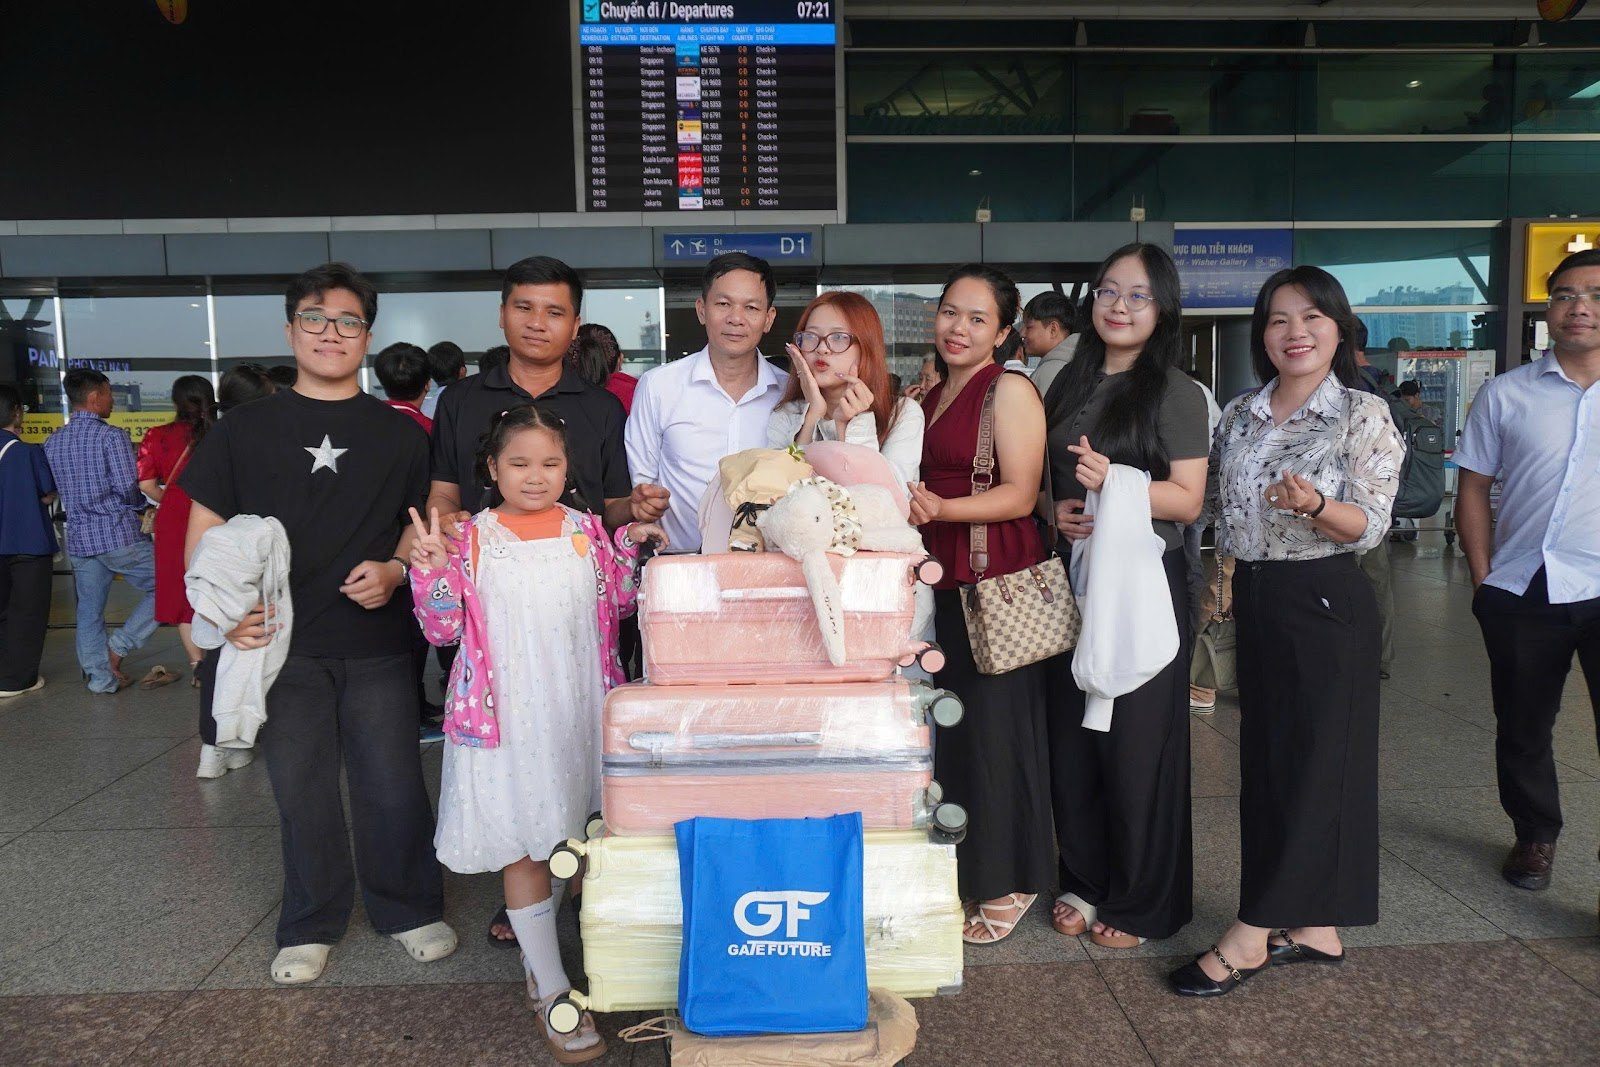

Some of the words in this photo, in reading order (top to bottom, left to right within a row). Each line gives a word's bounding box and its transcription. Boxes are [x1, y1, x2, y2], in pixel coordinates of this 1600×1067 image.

[600, 0, 644, 22] Chuyến
[647, 2, 660, 18] đi
[670, 2, 734, 22] Departures
[797, 2, 830, 18] 07:21
[640, 57, 664, 65] Singapore
[640, 68, 664, 76] Singapore
[641, 79, 664, 87] Singapore
[641, 90, 664, 98] Singapore
[641, 101, 665, 109] Singapore
[642, 112, 665, 120] Singapore
[642, 123, 665, 131] Singapore
[642, 134, 666, 142] Singapore
[642, 145, 666, 153] Singapore
[657, 156, 674, 164] Lumpur
[654, 178, 672, 187] Mueang
[780, 237, 805, 254] D1
[1220, 258, 1248, 267] Gallery
[734, 890, 830, 937] GF
